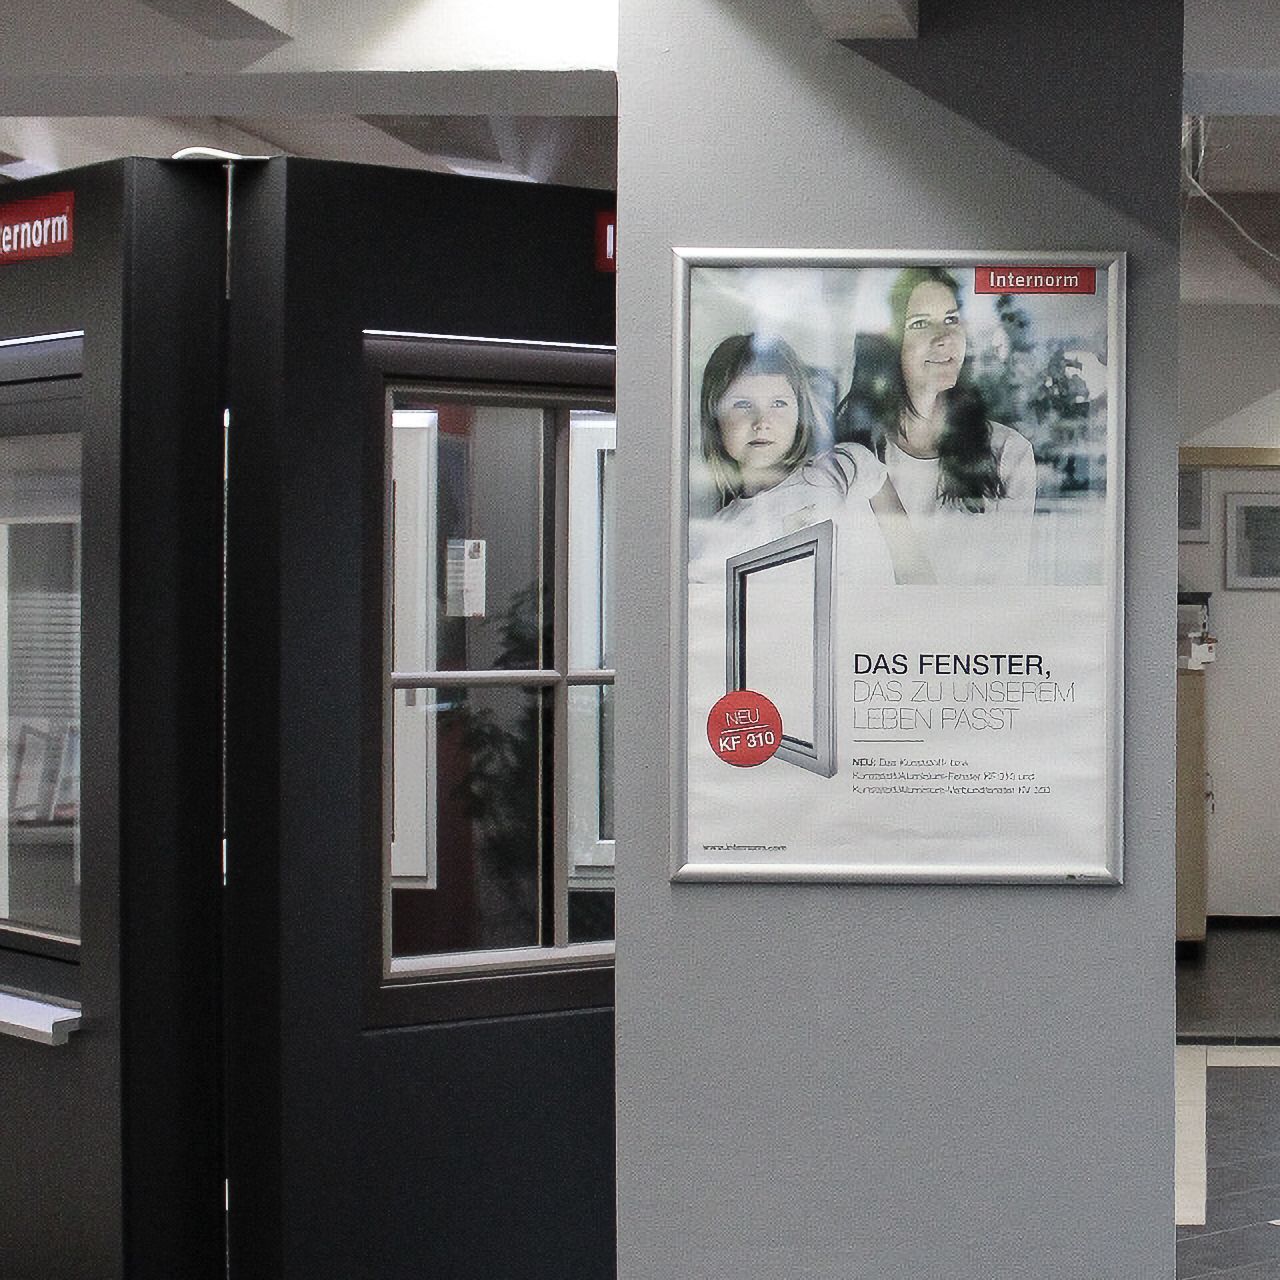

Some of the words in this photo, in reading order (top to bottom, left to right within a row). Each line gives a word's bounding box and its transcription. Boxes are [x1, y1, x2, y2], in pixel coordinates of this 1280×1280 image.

[0, 214, 68, 252] ernorm
[989, 271, 1079, 288] Internorm
[854, 653, 908, 675] DAS
[919, 654, 1051, 679] FENSTER,
[853, 680, 903, 703] DAS
[911, 680, 943, 702] ZU
[953, 680, 1075, 703] UNSEREM
[726, 708, 760, 726] NEU
[853, 707, 932, 730] LEBEN
[941, 707, 1021, 730] PASST
[719, 735, 741, 753] KF
[746, 731, 775, 748] 310
